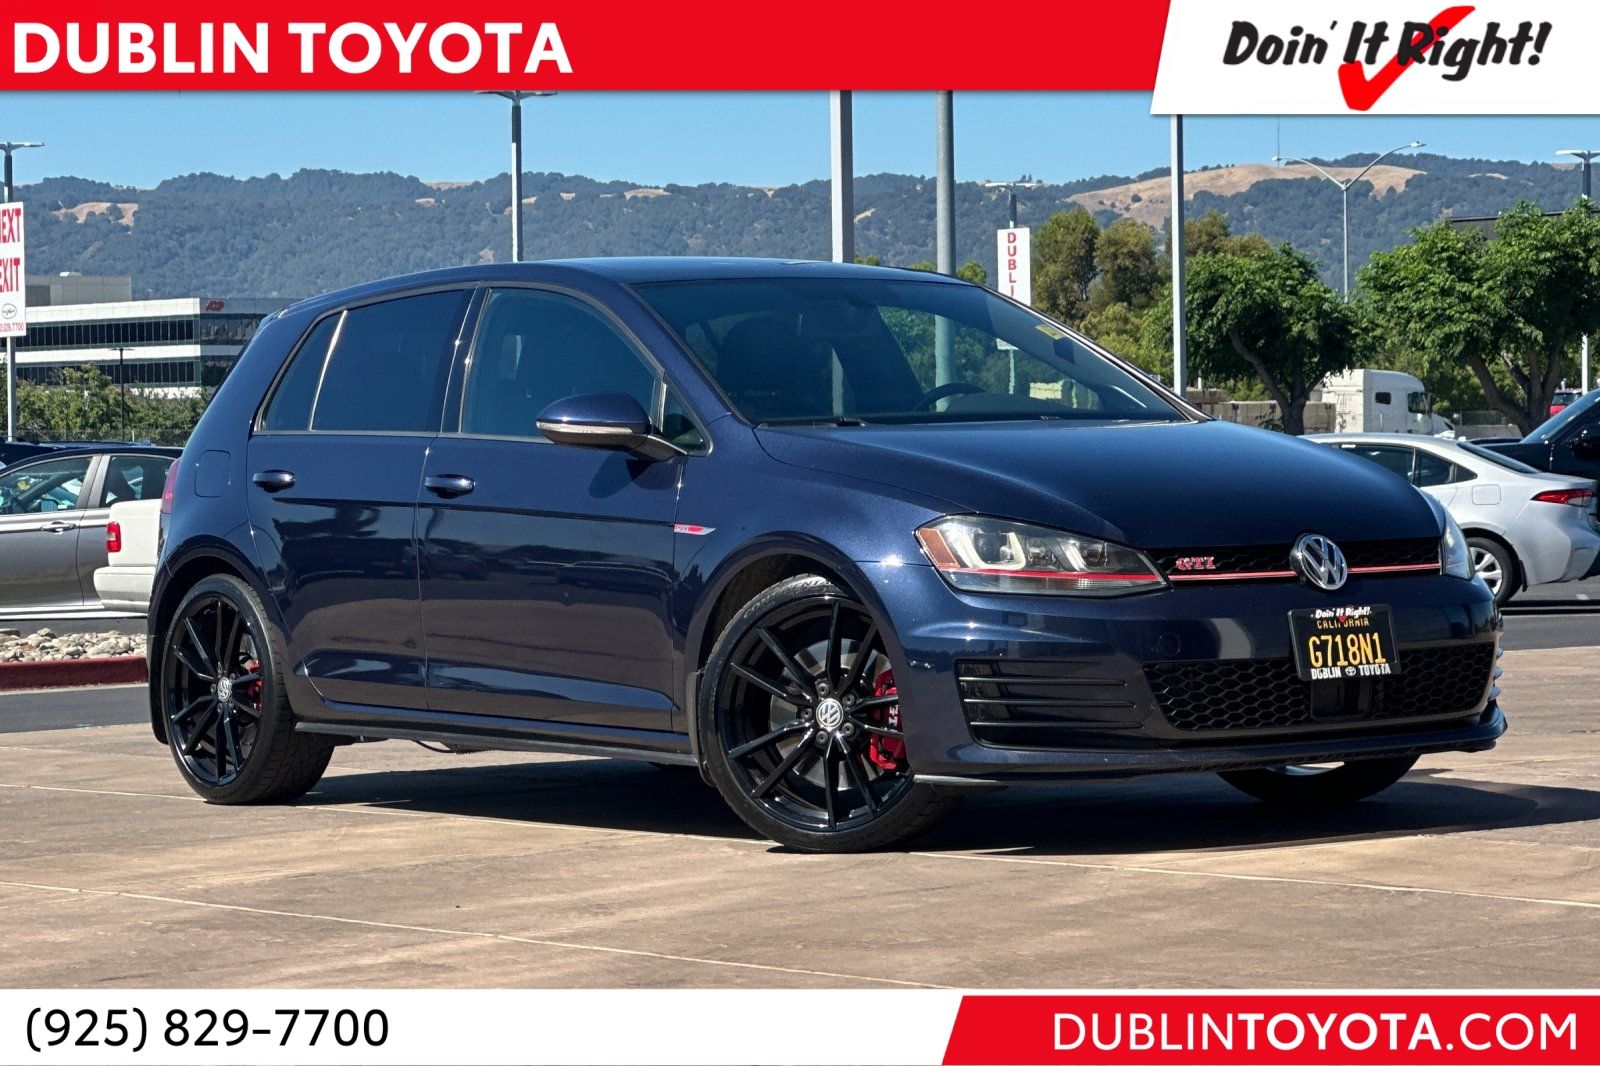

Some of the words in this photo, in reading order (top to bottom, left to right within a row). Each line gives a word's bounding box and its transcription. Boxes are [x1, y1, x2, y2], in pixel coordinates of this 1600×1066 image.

[0, 208, 21, 243] EXT
[1007, 231, 1018, 297] DUBLI
[1175, 556, 1216, 570] GTI
[1316, 617, 1370, 629] CALIORNIA
[1308, 632, 1387, 668] G718N1
[1310, 666, 1342, 680] DUBLIN
[1358, 662, 1392, 676] TOYOTA
